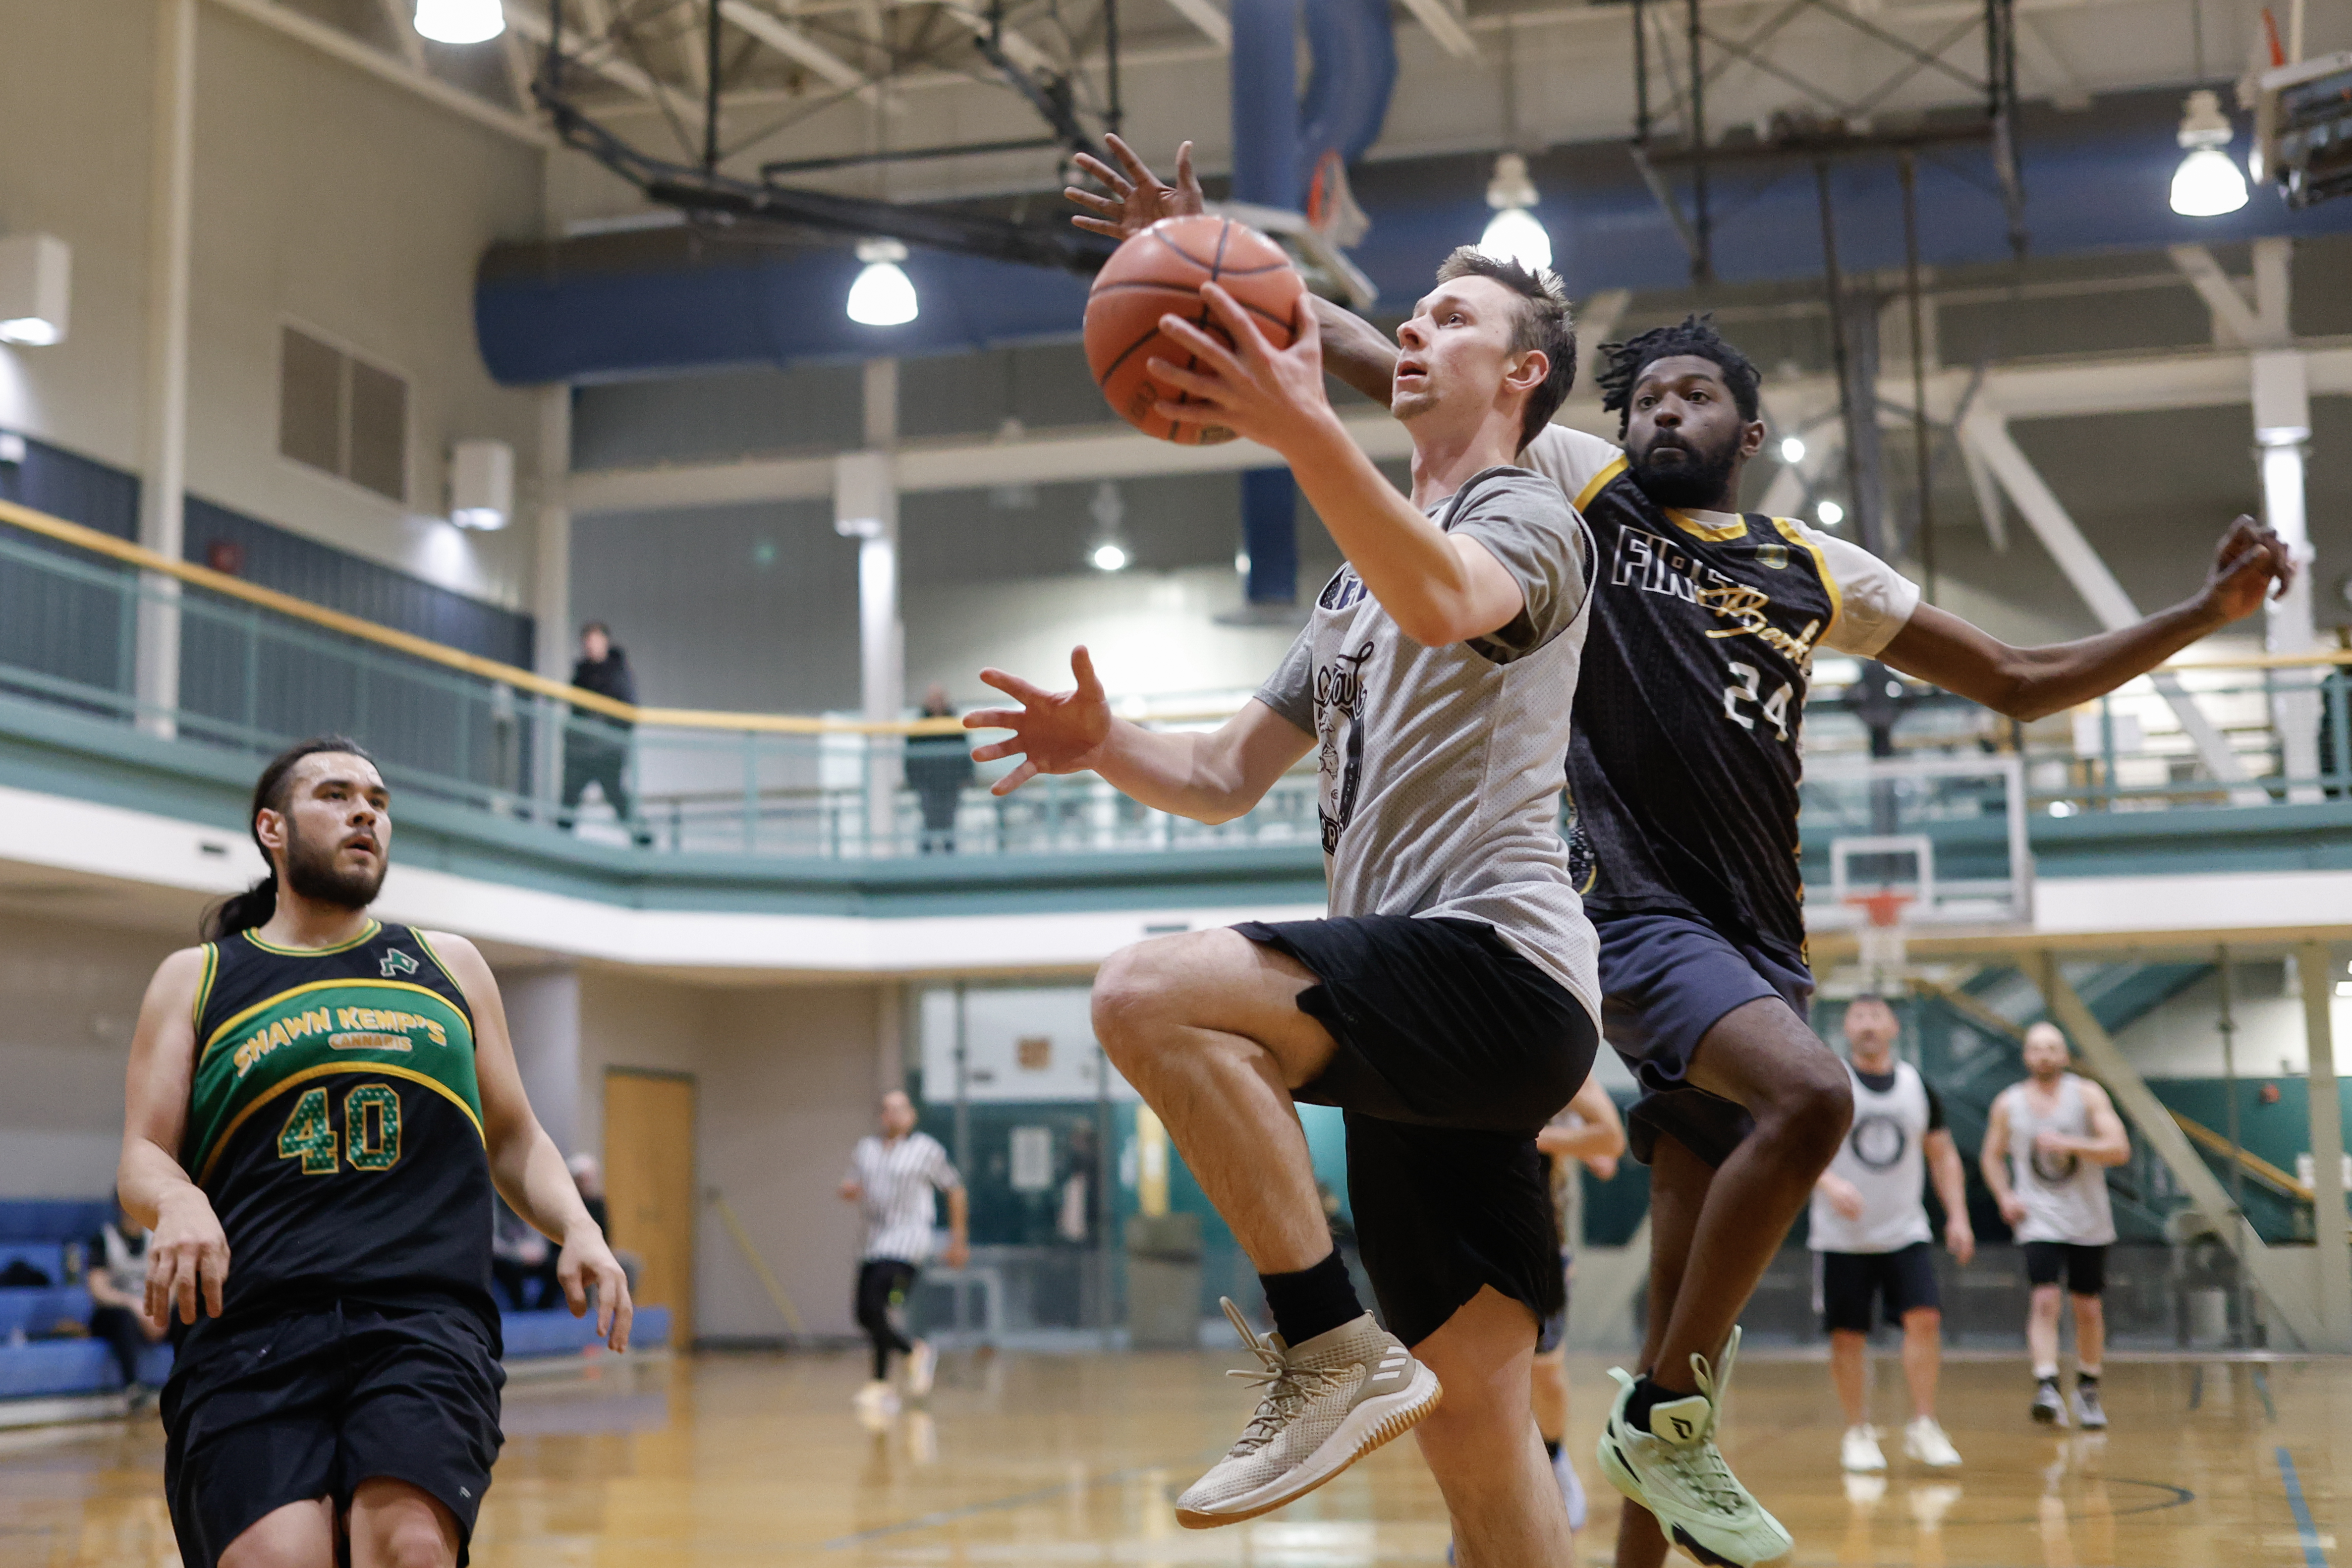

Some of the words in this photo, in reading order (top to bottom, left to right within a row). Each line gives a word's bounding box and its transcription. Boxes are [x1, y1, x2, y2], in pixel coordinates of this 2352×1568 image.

[1724, 661, 1794, 742] 24
[233, 1006, 332, 1078] SHAWN
[336, 1006, 447, 1047] KEMP'S
[329, 1033, 412, 1052] CANNABIS
[277, 1082, 402, 1175] 40
